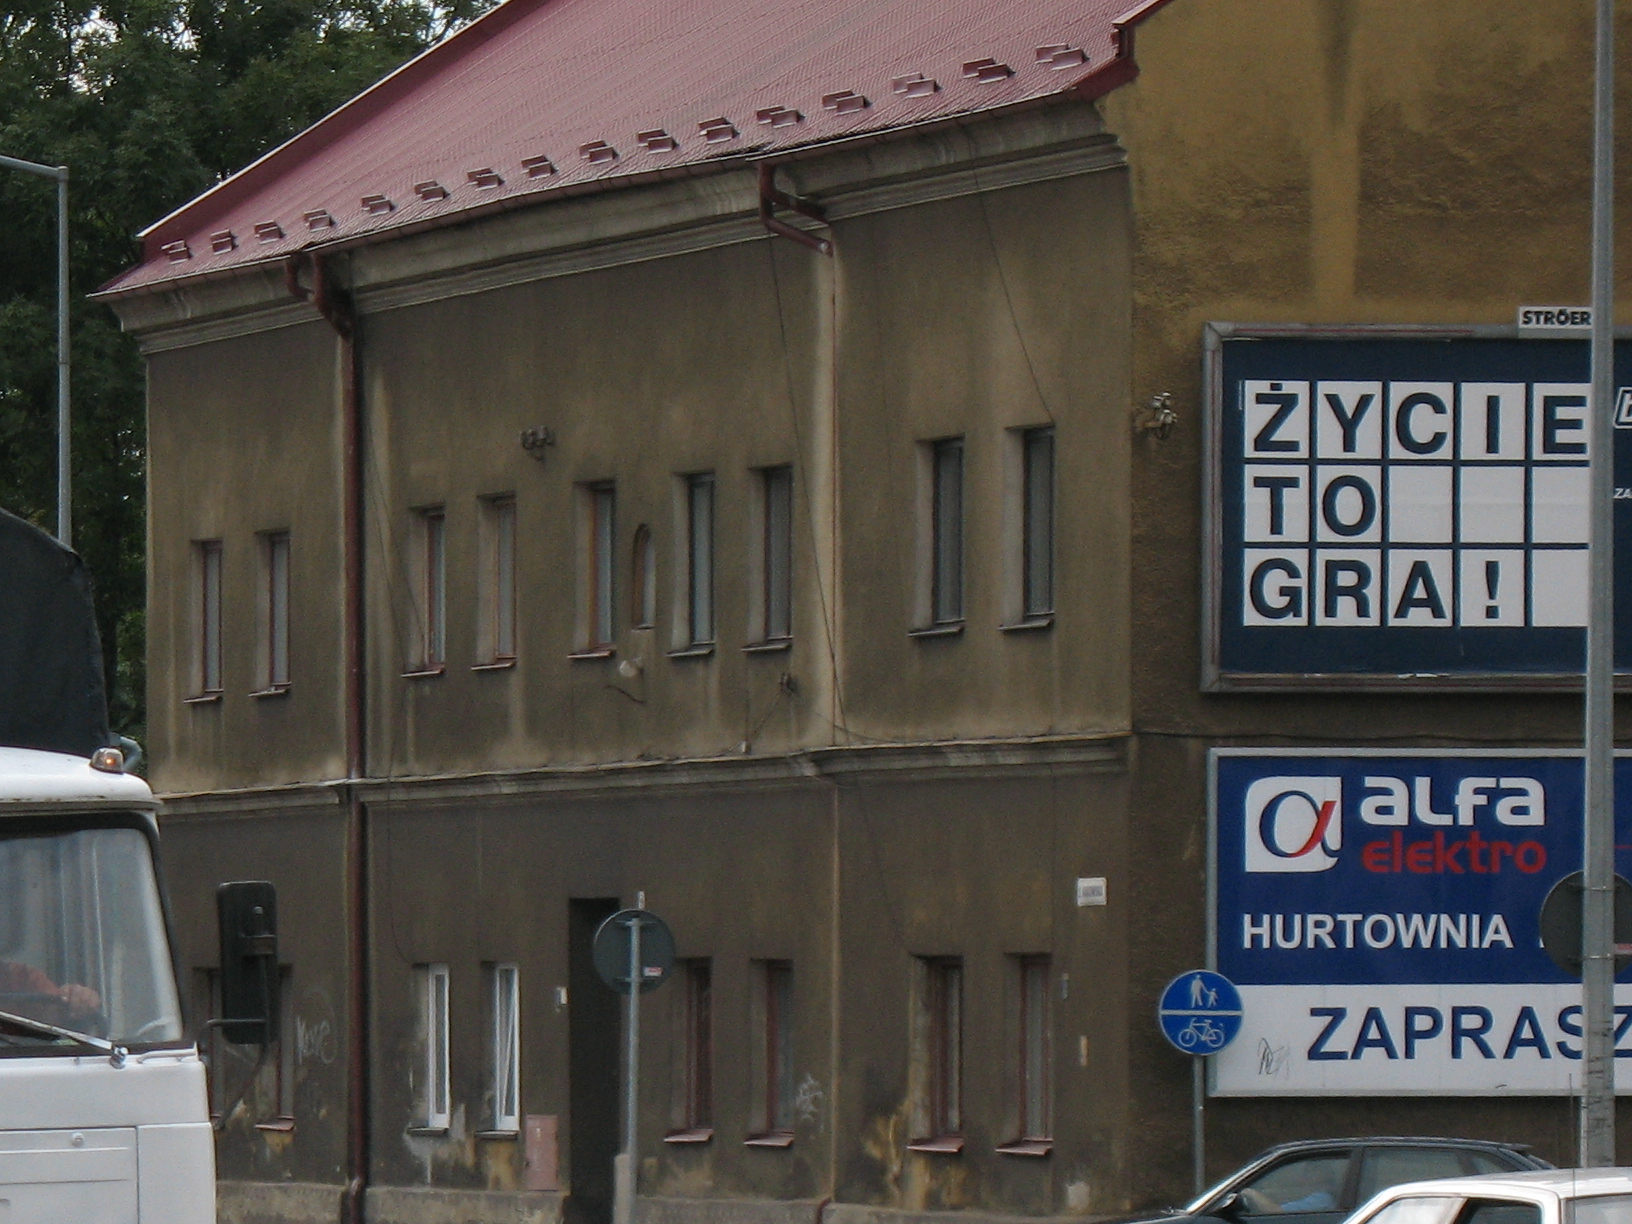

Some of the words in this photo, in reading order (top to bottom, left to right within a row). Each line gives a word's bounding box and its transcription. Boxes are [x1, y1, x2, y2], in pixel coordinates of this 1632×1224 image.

[1253, 383, 1588, 454] ŻYCIE
[1253, 475, 1376, 536] TO
[1250, 557, 1500, 619] GRA!
[1362, 830, 1547, 874] elektro
[1243, 913, 1514, 949] HURTOWNIA
